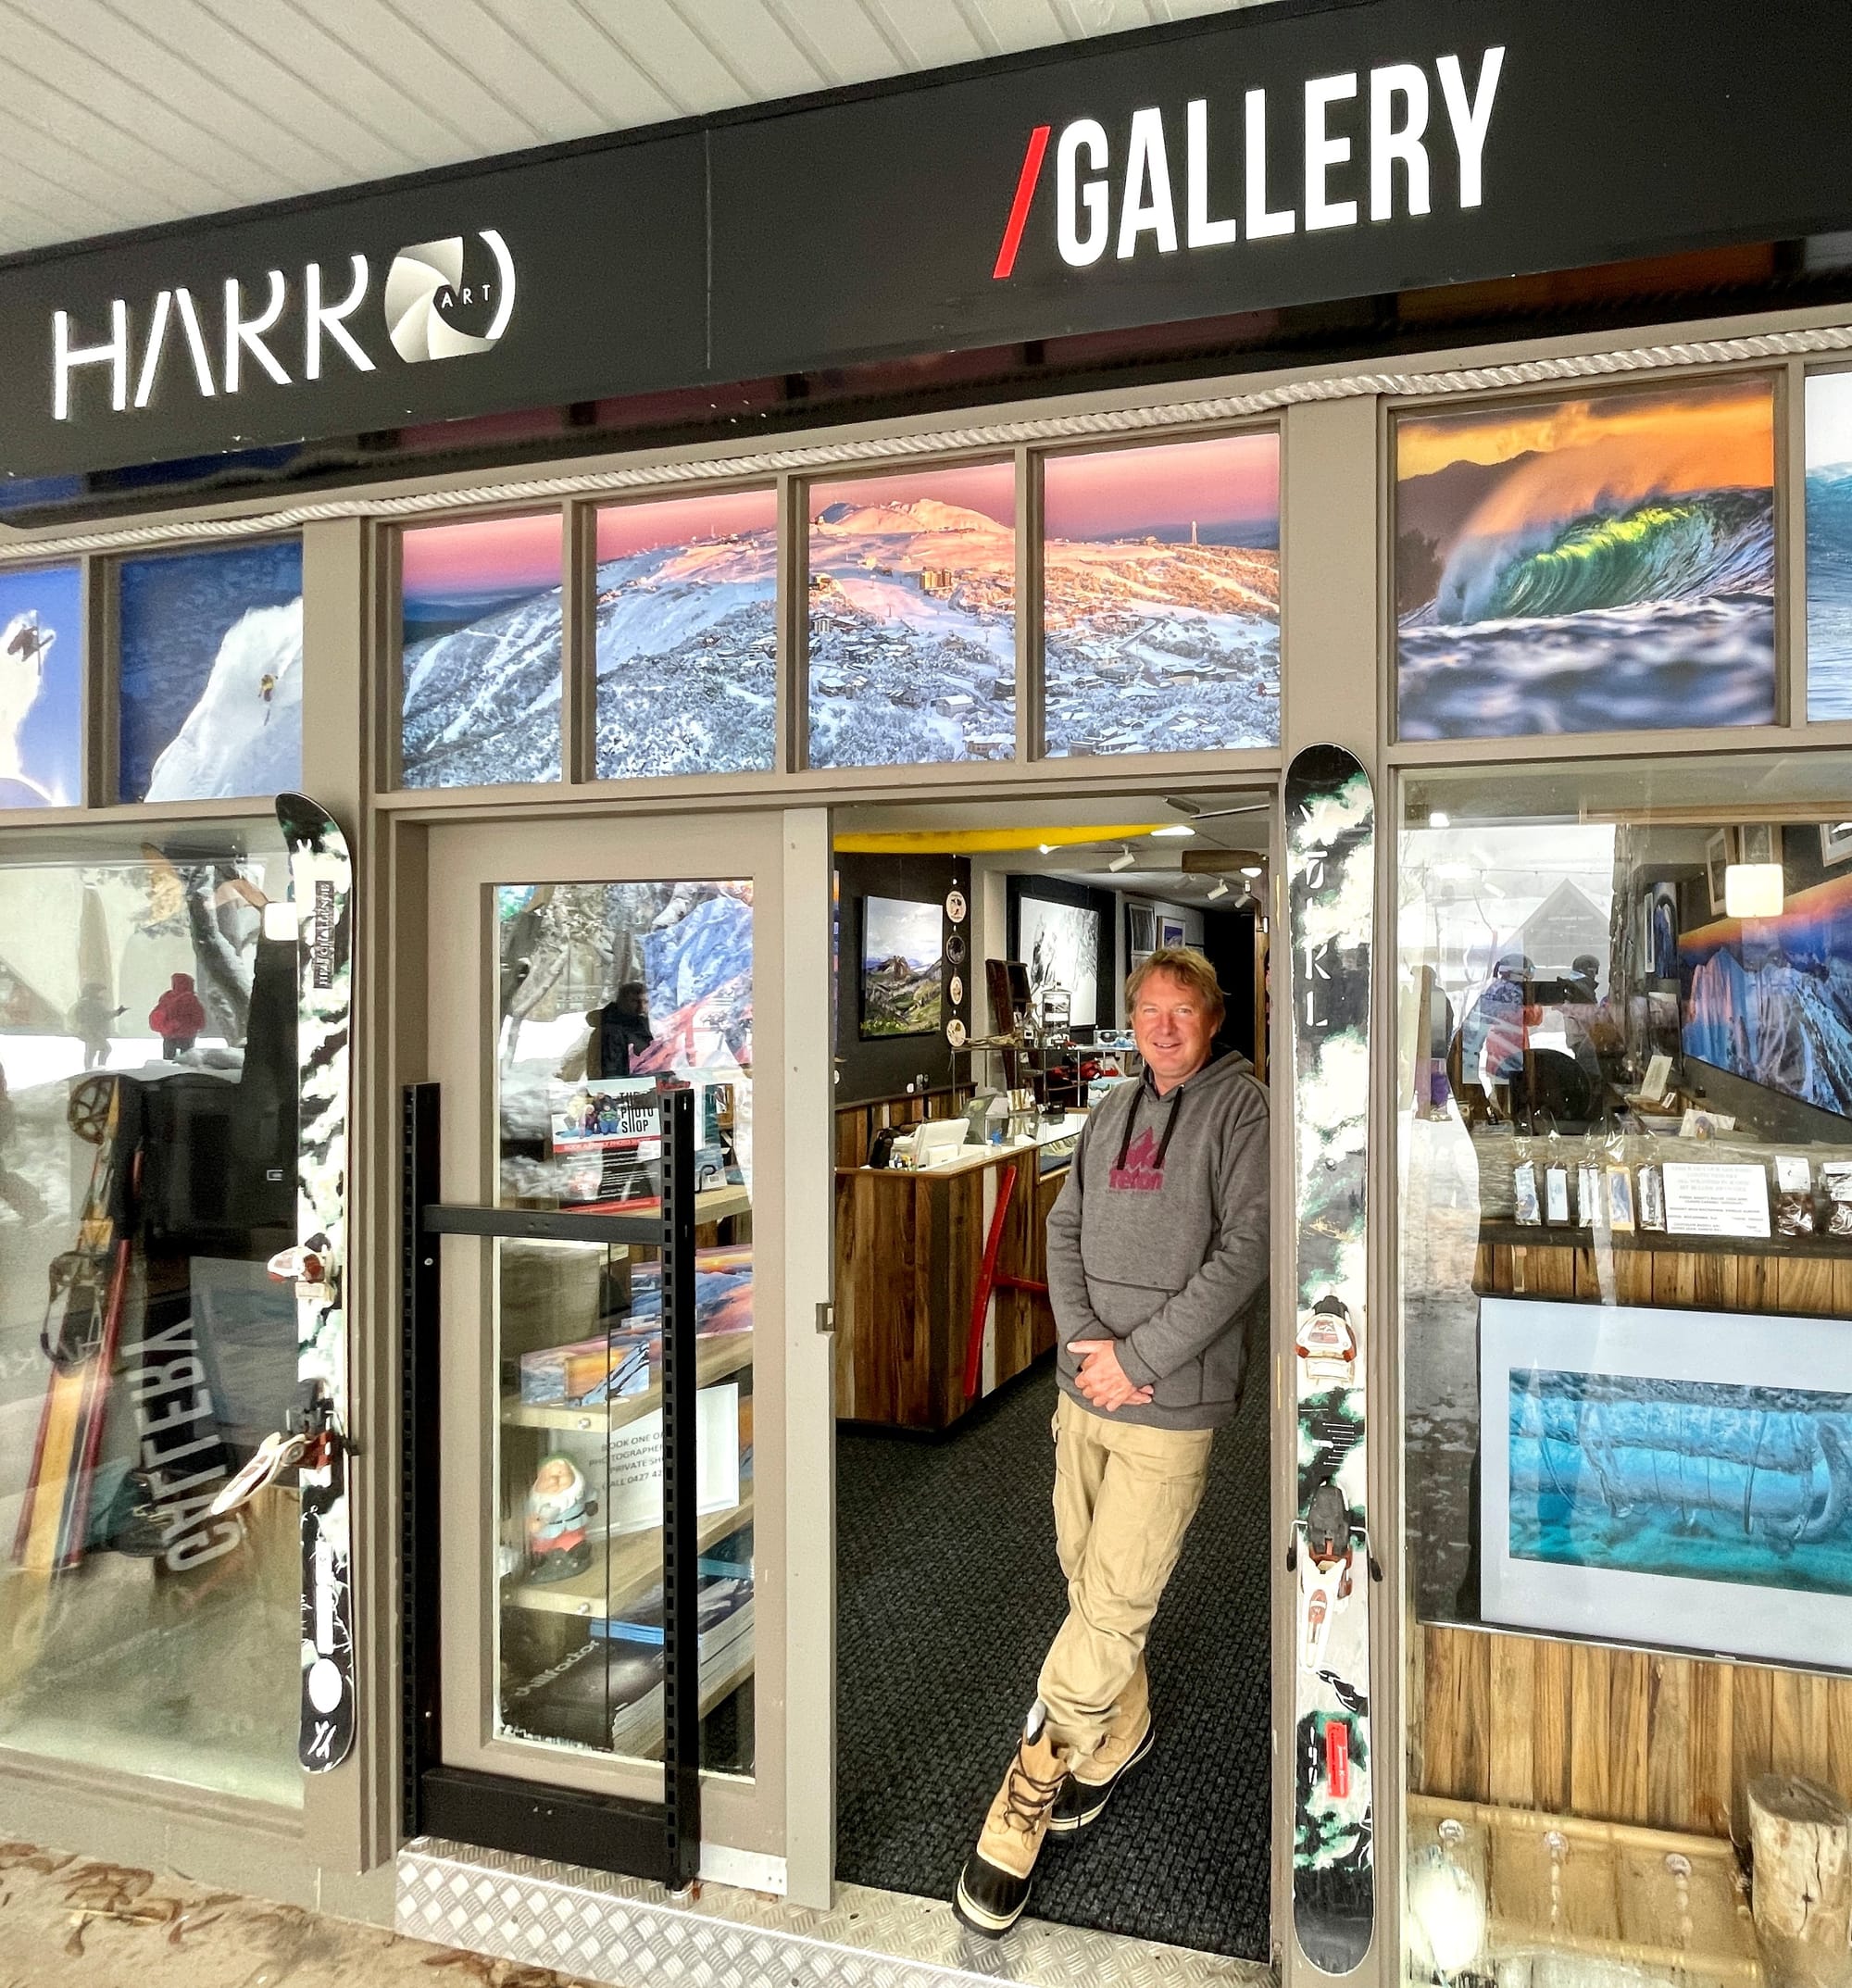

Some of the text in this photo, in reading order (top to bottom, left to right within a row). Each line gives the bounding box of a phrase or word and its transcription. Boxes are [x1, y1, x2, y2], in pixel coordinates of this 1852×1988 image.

[440, 281, 493, 309] ART
[631, 1434, 650, 1444] ONE
[609, 1459, 647, 1473] PRIVATE
